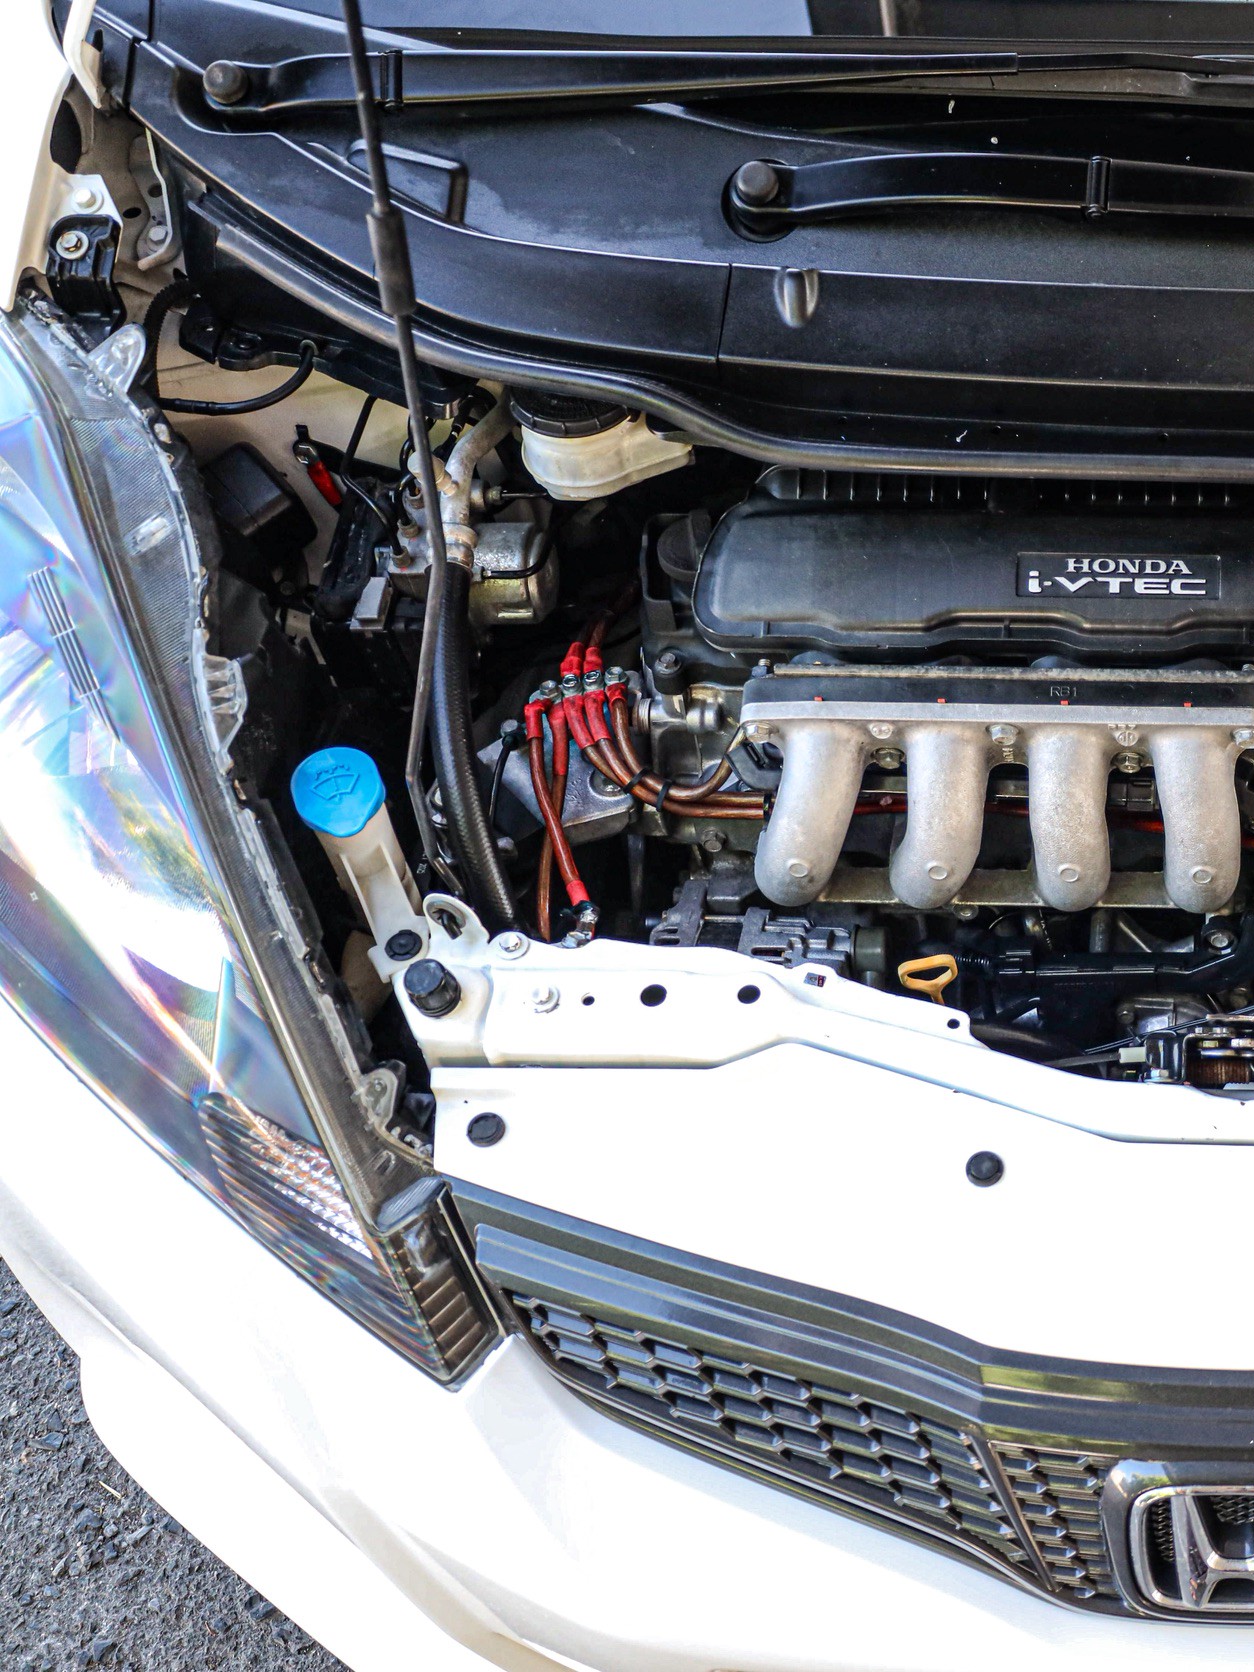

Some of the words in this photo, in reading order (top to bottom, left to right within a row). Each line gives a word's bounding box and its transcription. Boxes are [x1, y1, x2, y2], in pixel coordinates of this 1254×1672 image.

[1065, 558, 1193, 575] HONDA
[1028, 570, 1207, 595] i-VTEC
[1049, 686, 1078, 698] RB1
